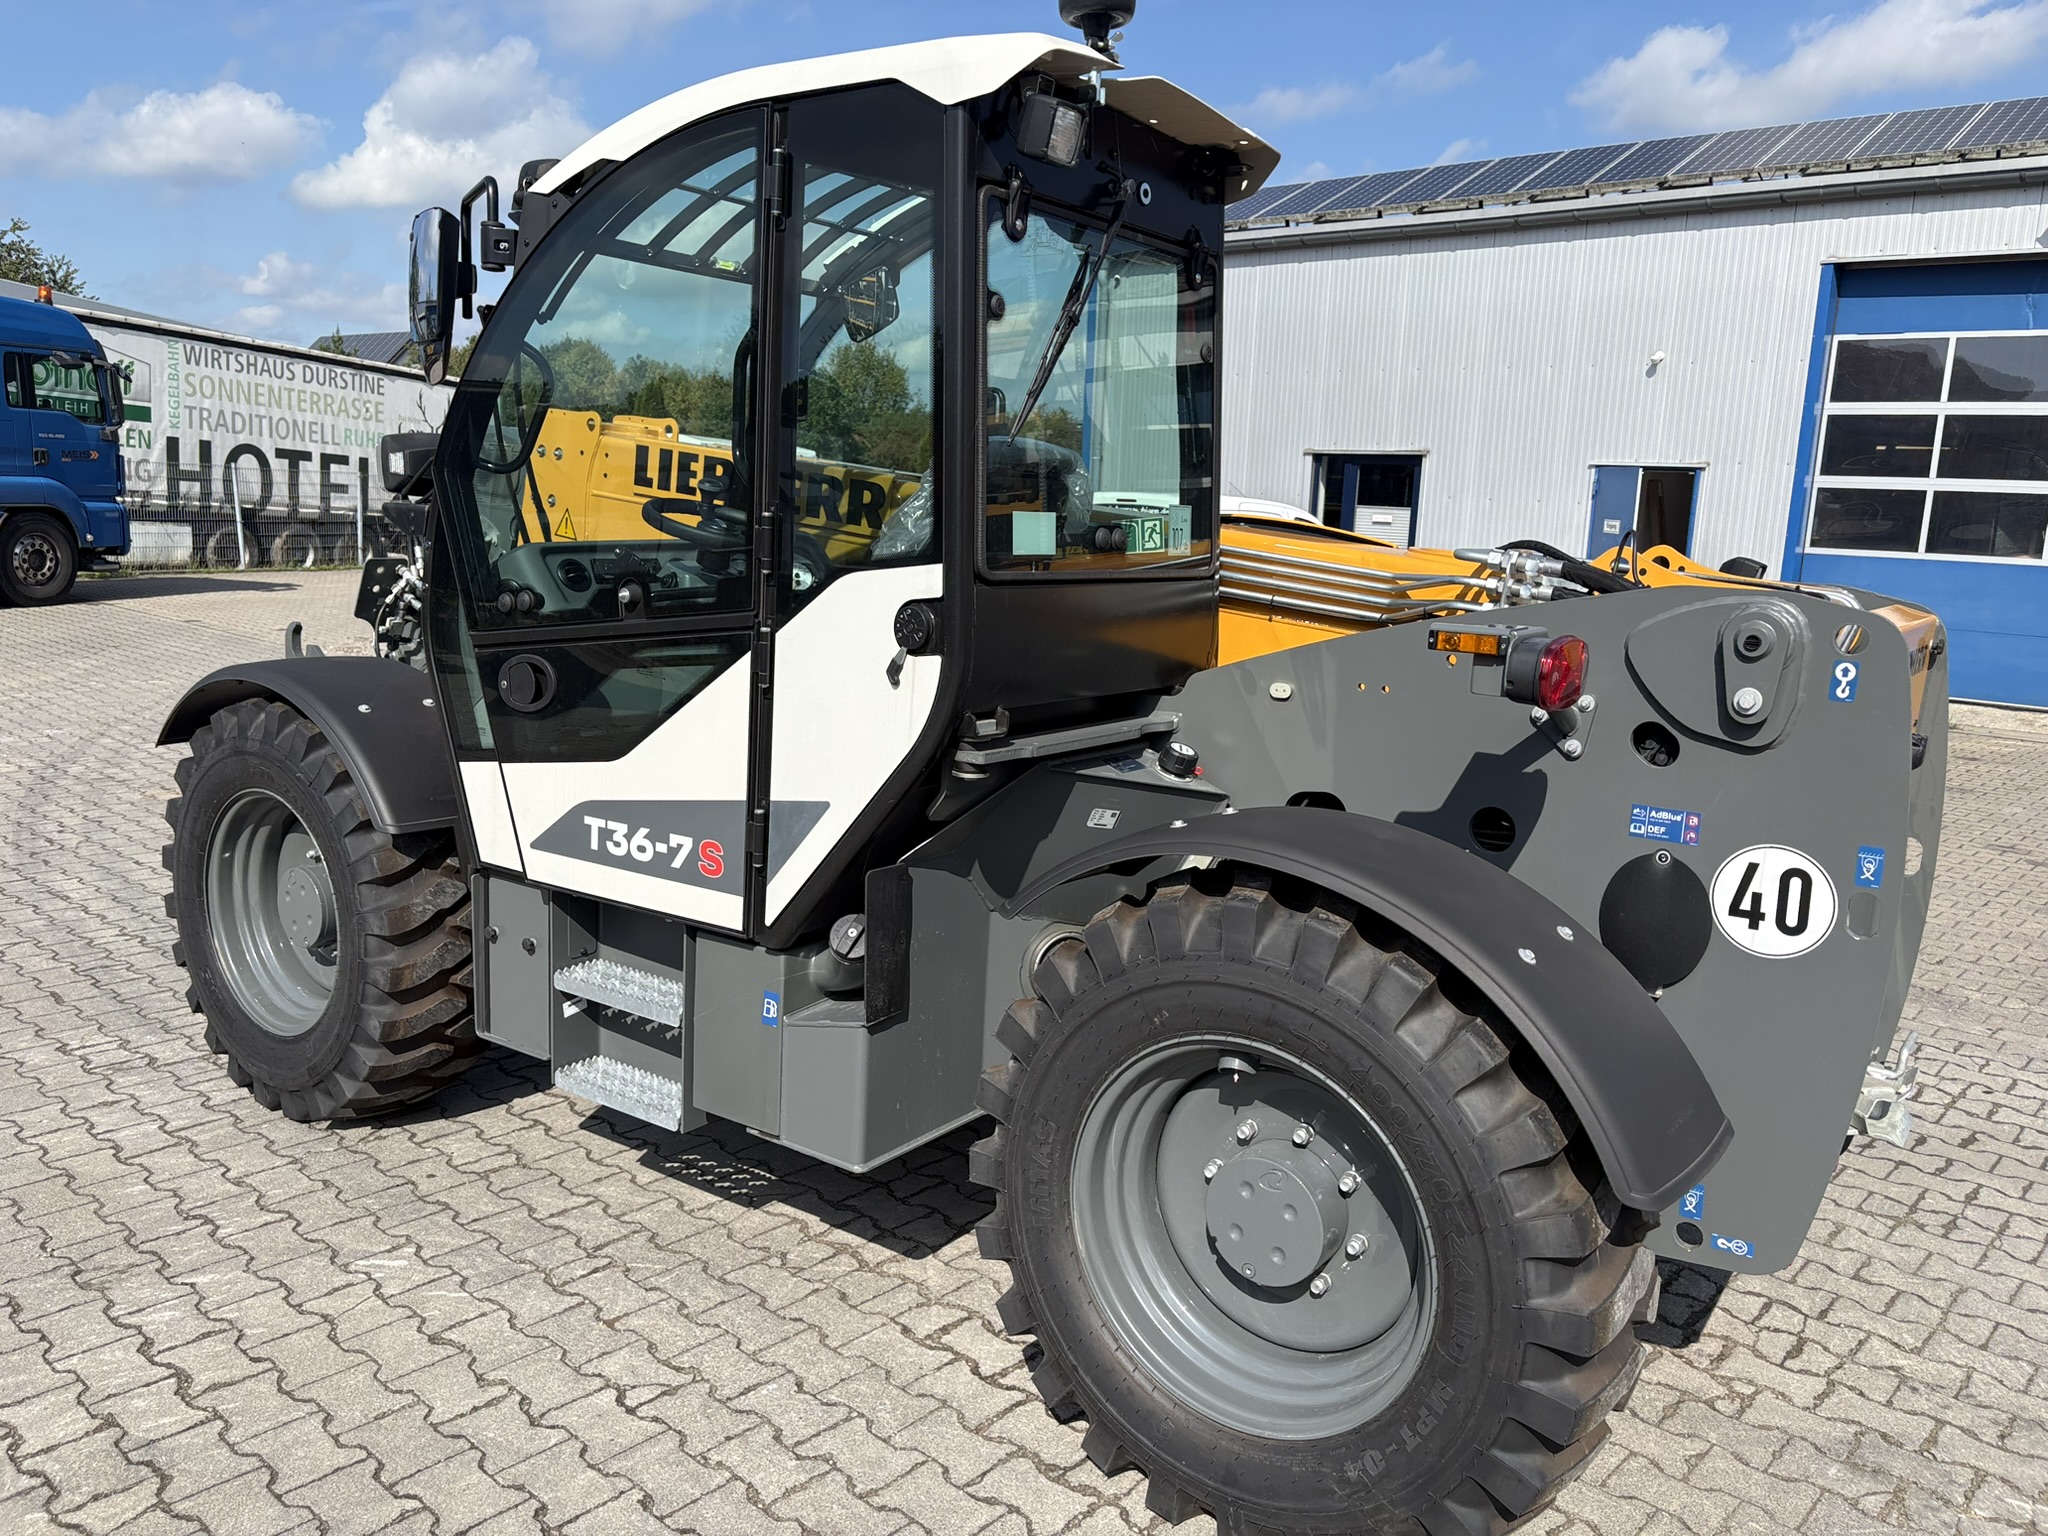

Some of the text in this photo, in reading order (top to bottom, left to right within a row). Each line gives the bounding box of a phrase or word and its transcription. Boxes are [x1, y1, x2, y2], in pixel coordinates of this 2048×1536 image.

[167, 339, 180, 430] KEGELBAHN
[183, 343, 385, 397] WIRTSHAUS DURSTINE
[183, 372, 385, 424] SONNENTERRASSE
[183, 404, 341, 447] TRADITIONELL
[1647, 824, 1667, 835] DEF
[1728, 861, 1813, 937] 40
